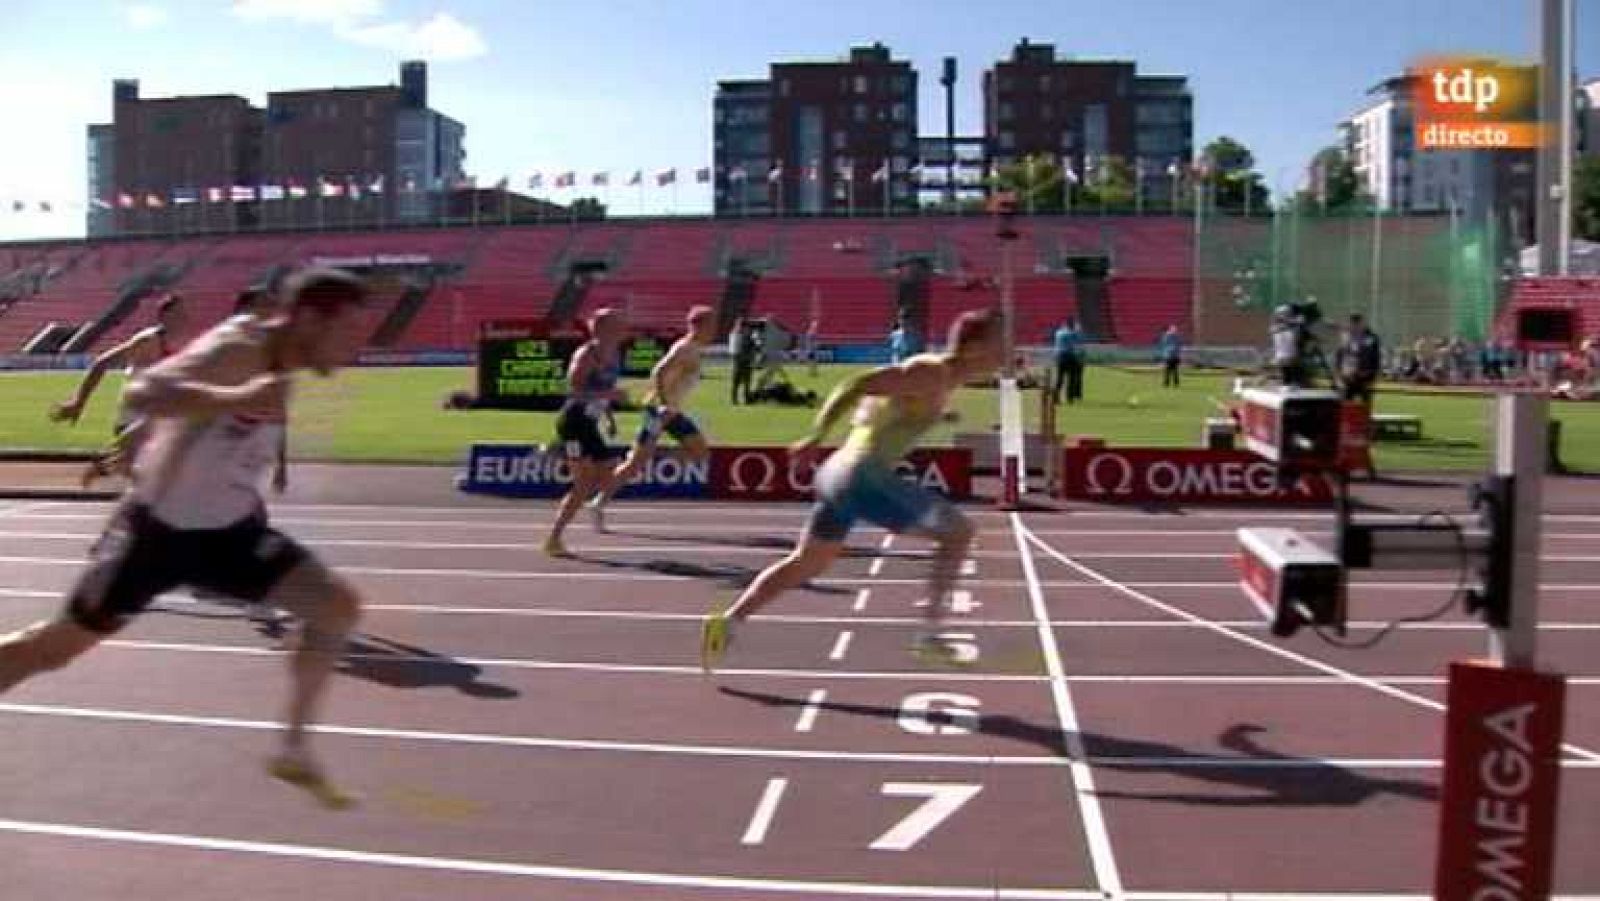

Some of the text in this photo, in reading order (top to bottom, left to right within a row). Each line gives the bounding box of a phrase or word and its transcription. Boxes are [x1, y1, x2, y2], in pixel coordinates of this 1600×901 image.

[787, 459, 949, 492] OGA
[897, 692, 983, 735] 6
[867, 782, 984, 851] 7
